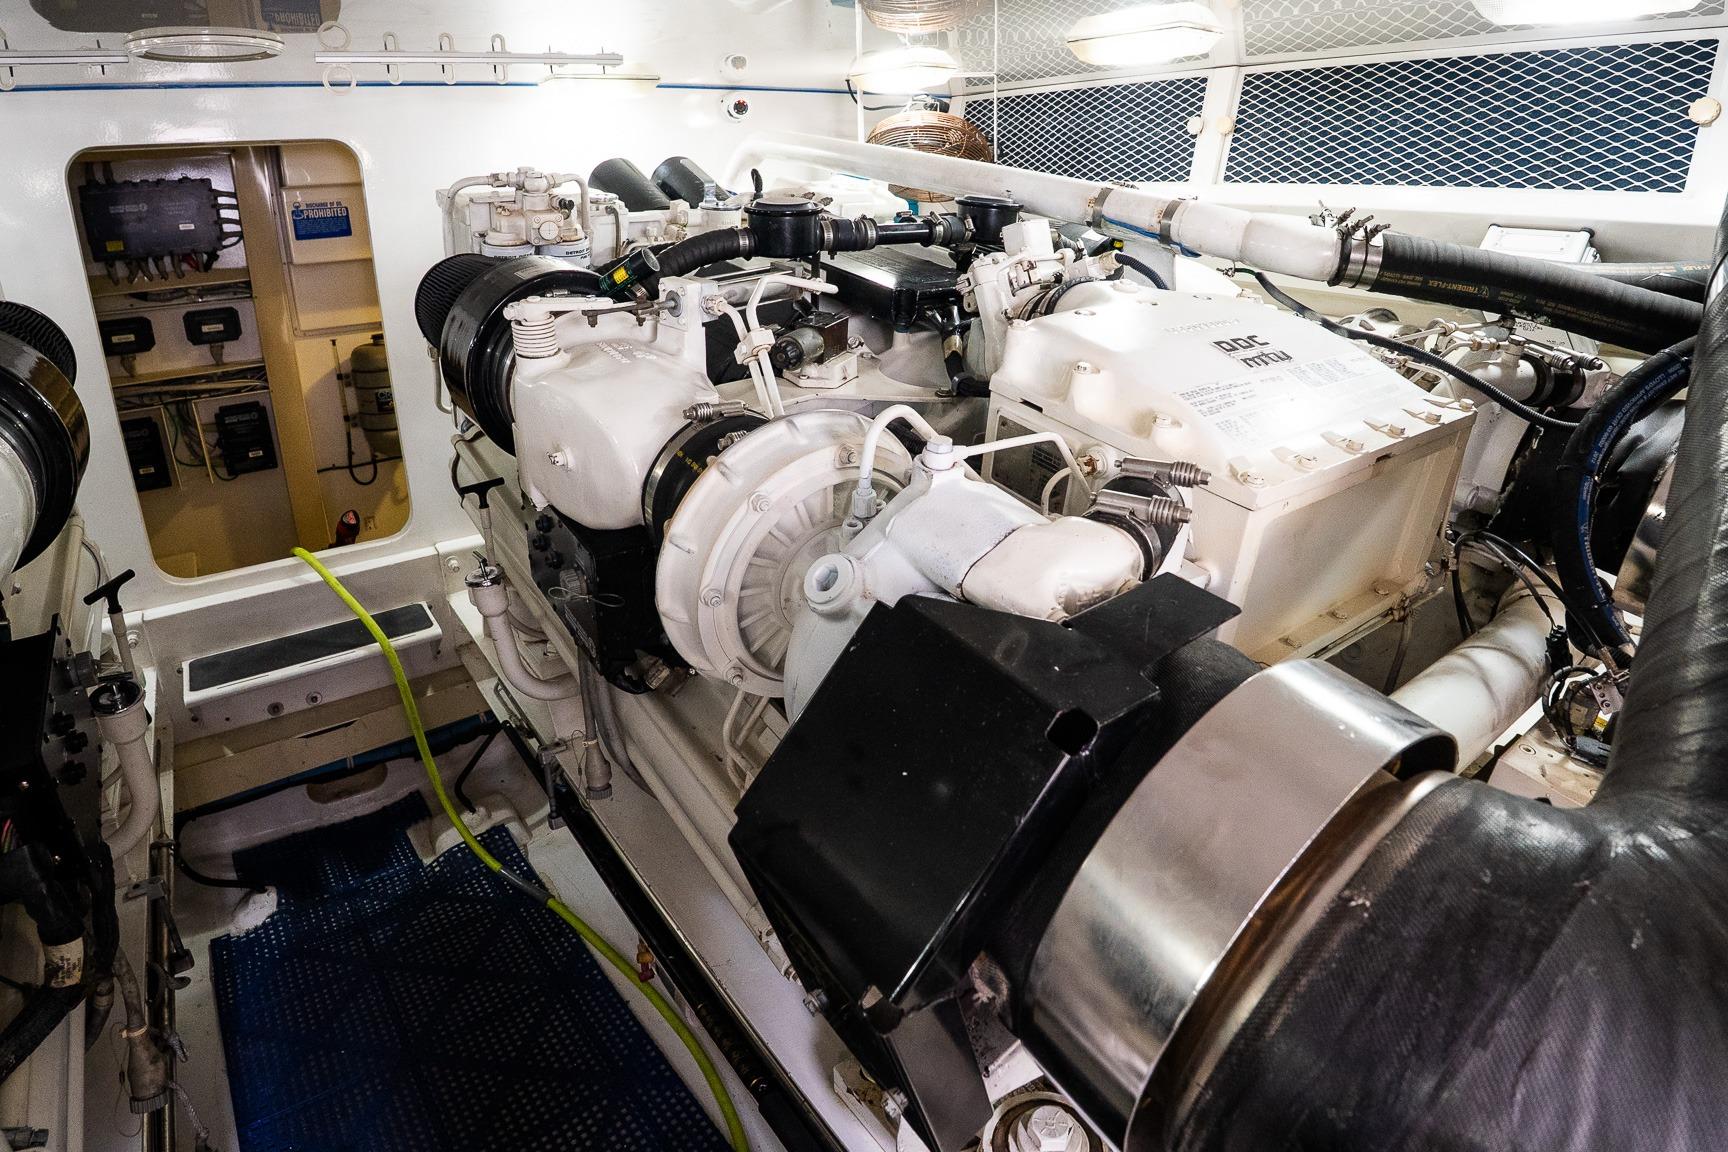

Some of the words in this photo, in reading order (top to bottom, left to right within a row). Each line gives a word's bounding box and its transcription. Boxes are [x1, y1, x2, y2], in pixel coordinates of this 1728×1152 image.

[303, 208, 347, 219] PROHIBITED
[1428, 279, 1479, 294] TRIDENT-FLEX
[1213, 335, 1270, 352] DDC
[1240, 350, 1293, 368] mtu
